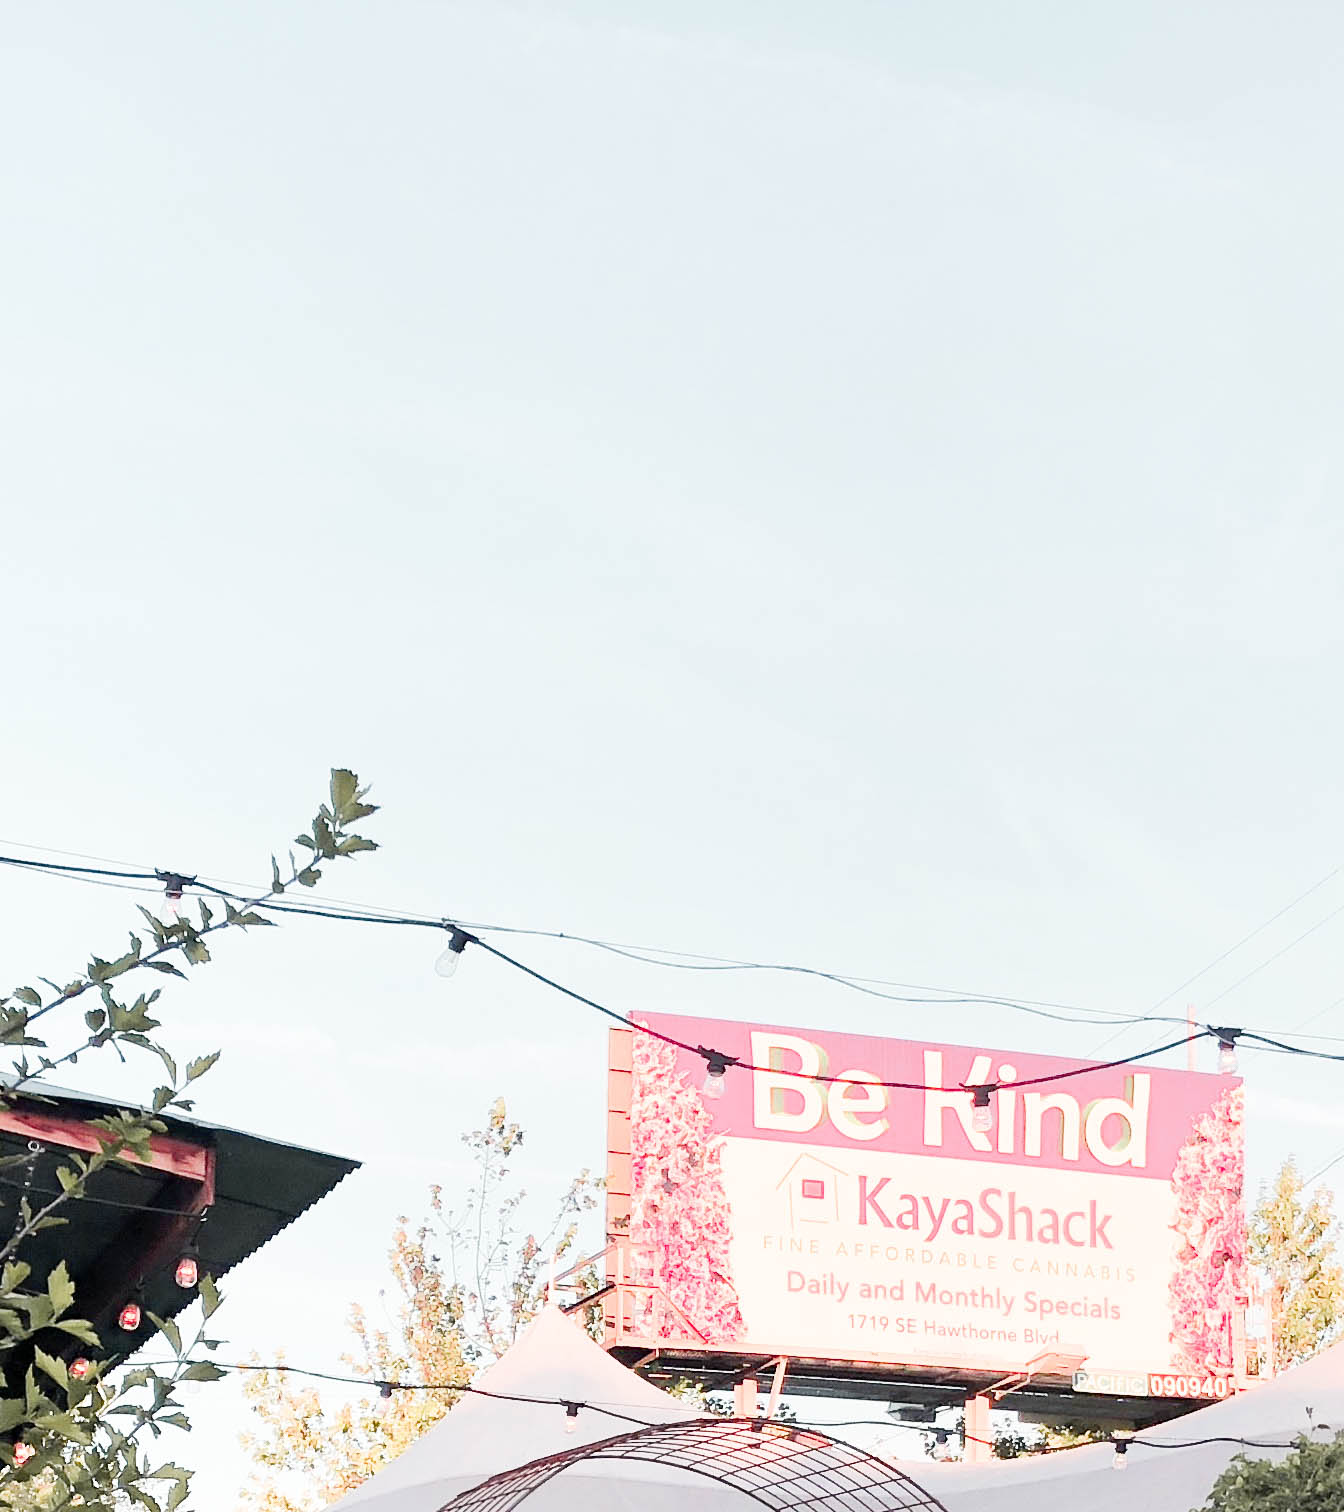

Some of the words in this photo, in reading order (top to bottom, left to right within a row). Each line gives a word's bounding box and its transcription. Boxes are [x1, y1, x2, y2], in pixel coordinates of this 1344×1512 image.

[750, 1031, 888, 1141] Be
[923, 1050, 1151, 1168] Kind
[858, 1175, 1114, 1250] KayaShack
[763, 1235, 819, 1254] FINE
[836, 1242, 997, 1269] AFFORDABLE
[1012, 1257, 1136, 1282] CANNABIS
[787, 1270, 849, 1303] Daily
[859, 1280, 904, 1301] and
[916, 1281, 1014, 1316] Monthly
[1024, 1291, 1121, 1320] Specials
[848, 1314, 889, 1332] 1719
[896, 1317, 917, 1334] SE
[924, 1320, 1016, 1342] Hawthorne
[1151, 1376, 1227, 1397] 090940
